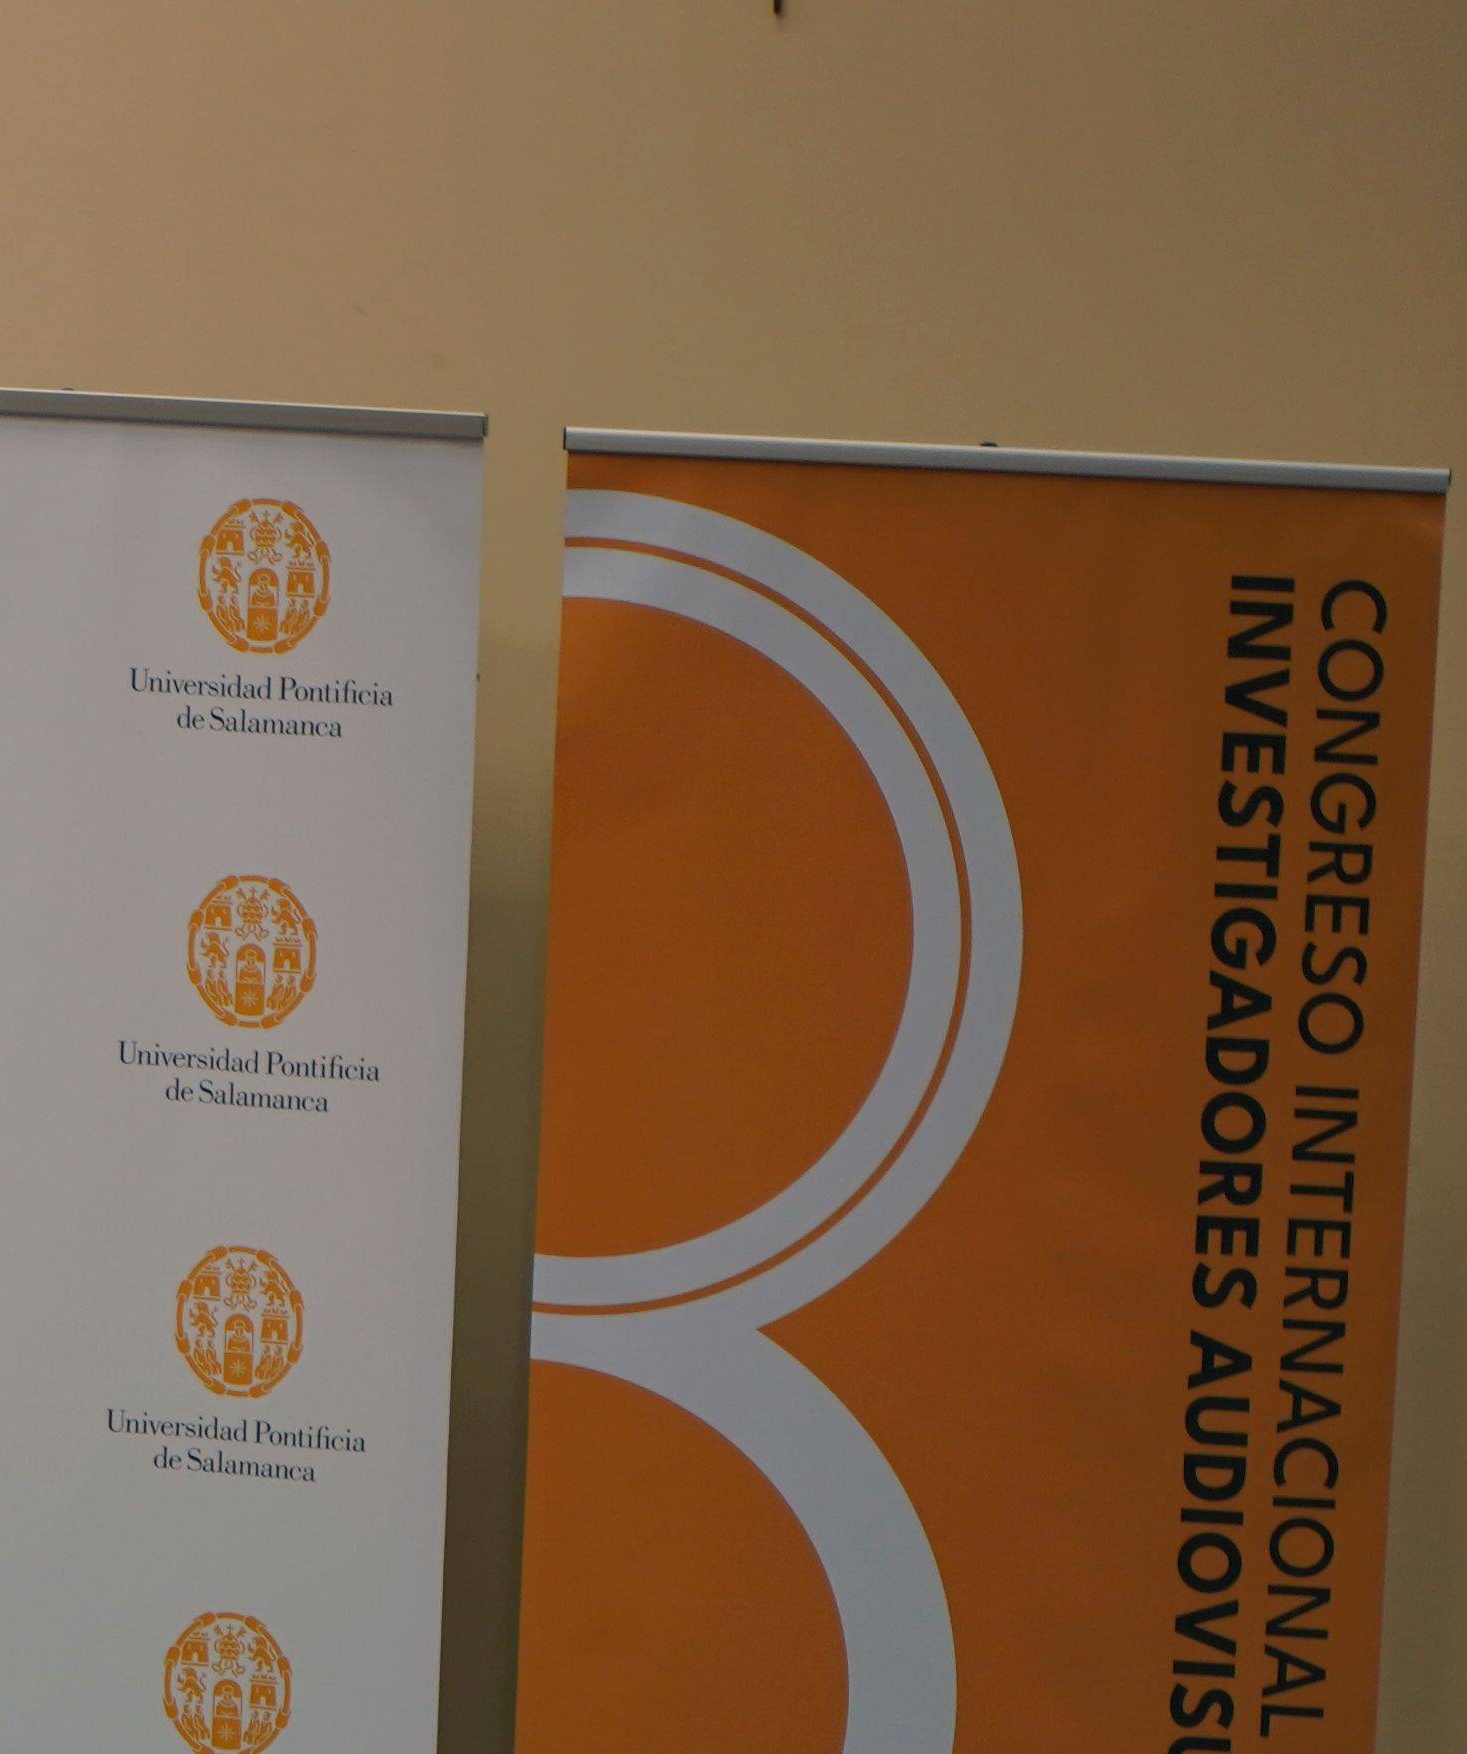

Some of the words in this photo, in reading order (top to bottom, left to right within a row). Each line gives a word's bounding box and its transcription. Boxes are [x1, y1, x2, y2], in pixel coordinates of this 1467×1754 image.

[130, 666, 274, 702] Universidad
[279, 676, 395, 709] Pontificia
[176, 706, 206, 732] de
[209, 708, 343, 740] Salamanca
[1297, 580, 1388, 1055] CONGRESO
[1191, 575, 1296, 1311] INVESTIGADORES
[117, 1040, 261, 1076] Universidad
[265, 1051, 382, 1083] Pontificia
[164, 1080, 195, 1105] de
[198, 1081, 330, 1114] Salamanca
[106, 1408, 249, 1445] Universidad
[254, 1420, 367, 1453] Pontificia
[1260, 1085, 1360, 1738] INTERNACIONAL
[152, 1447, 183, 1473] de
[186, 1450, 317, 1484] Salamanca
